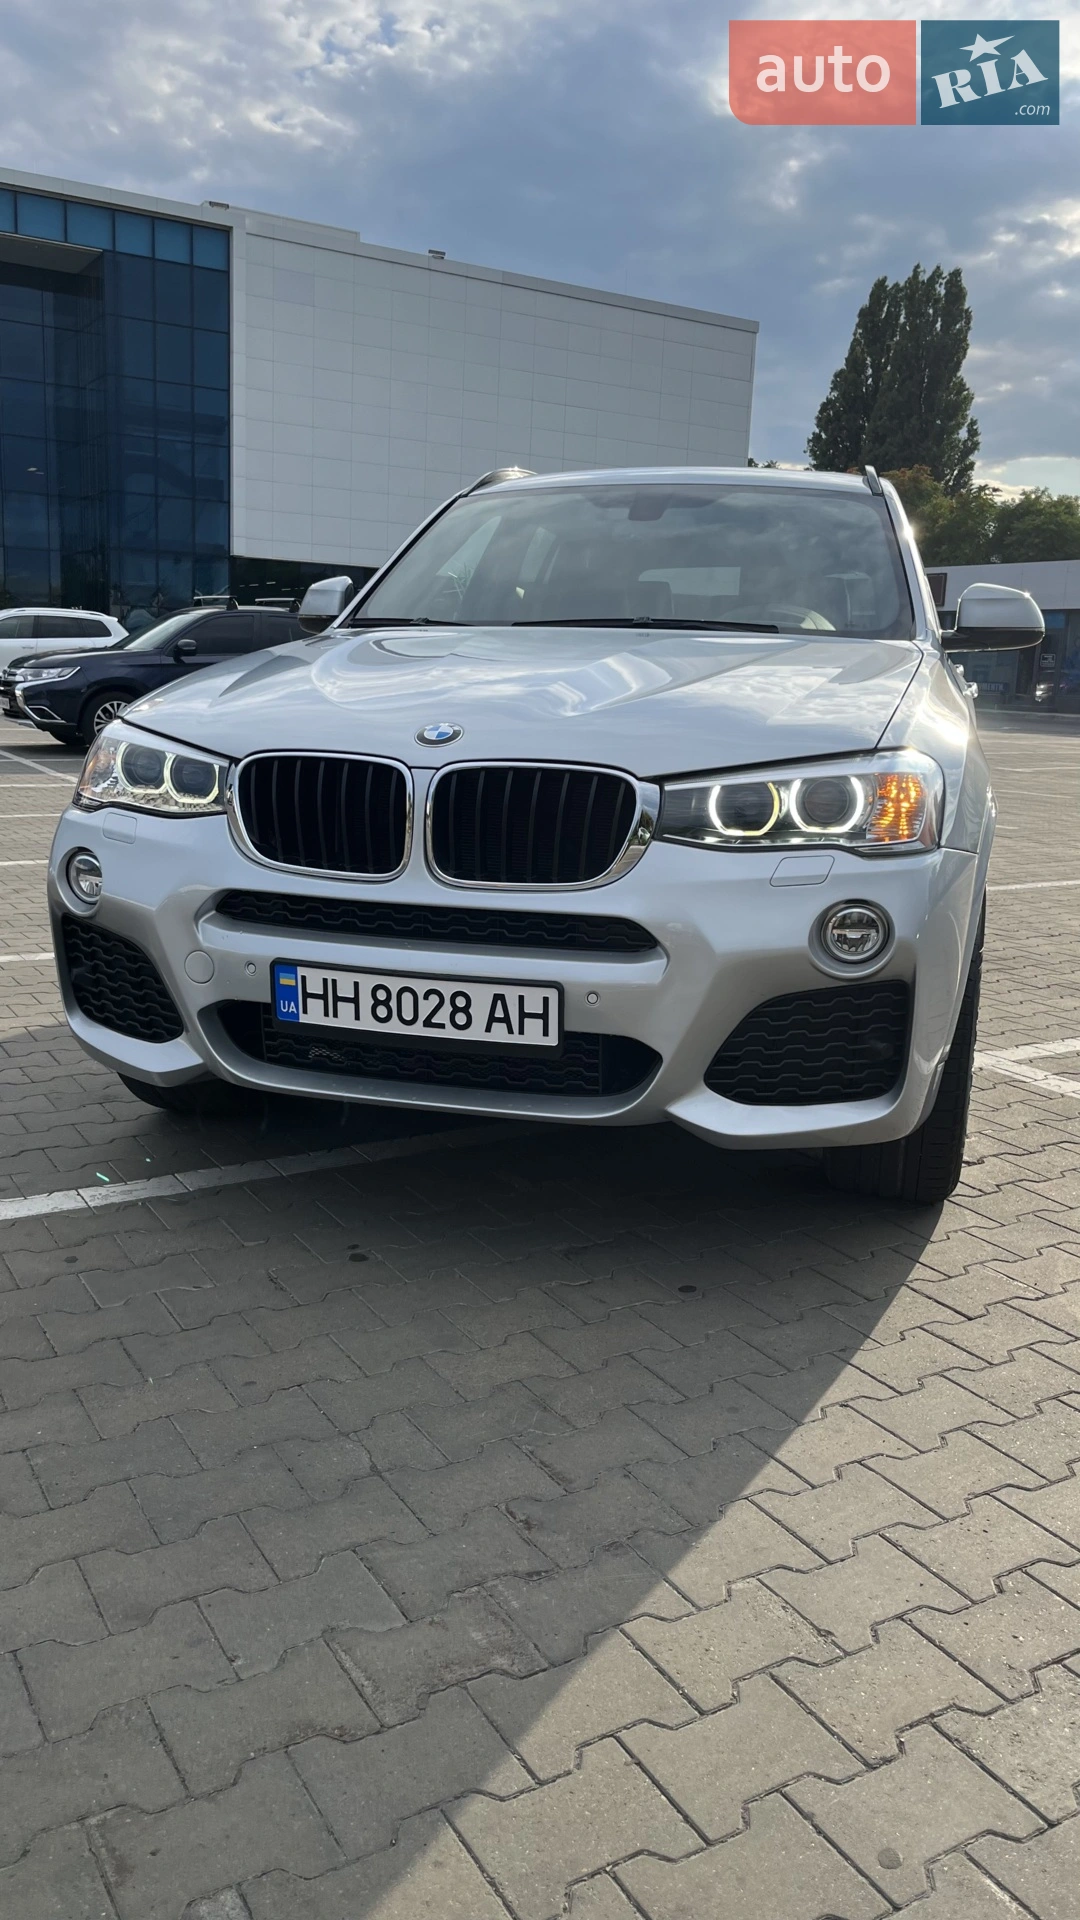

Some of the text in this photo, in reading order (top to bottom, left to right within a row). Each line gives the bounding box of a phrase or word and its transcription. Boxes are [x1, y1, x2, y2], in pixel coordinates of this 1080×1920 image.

[280, 1000, 297, 1014] UA
[300, 974, 550, 1037] HH 8028 AH
